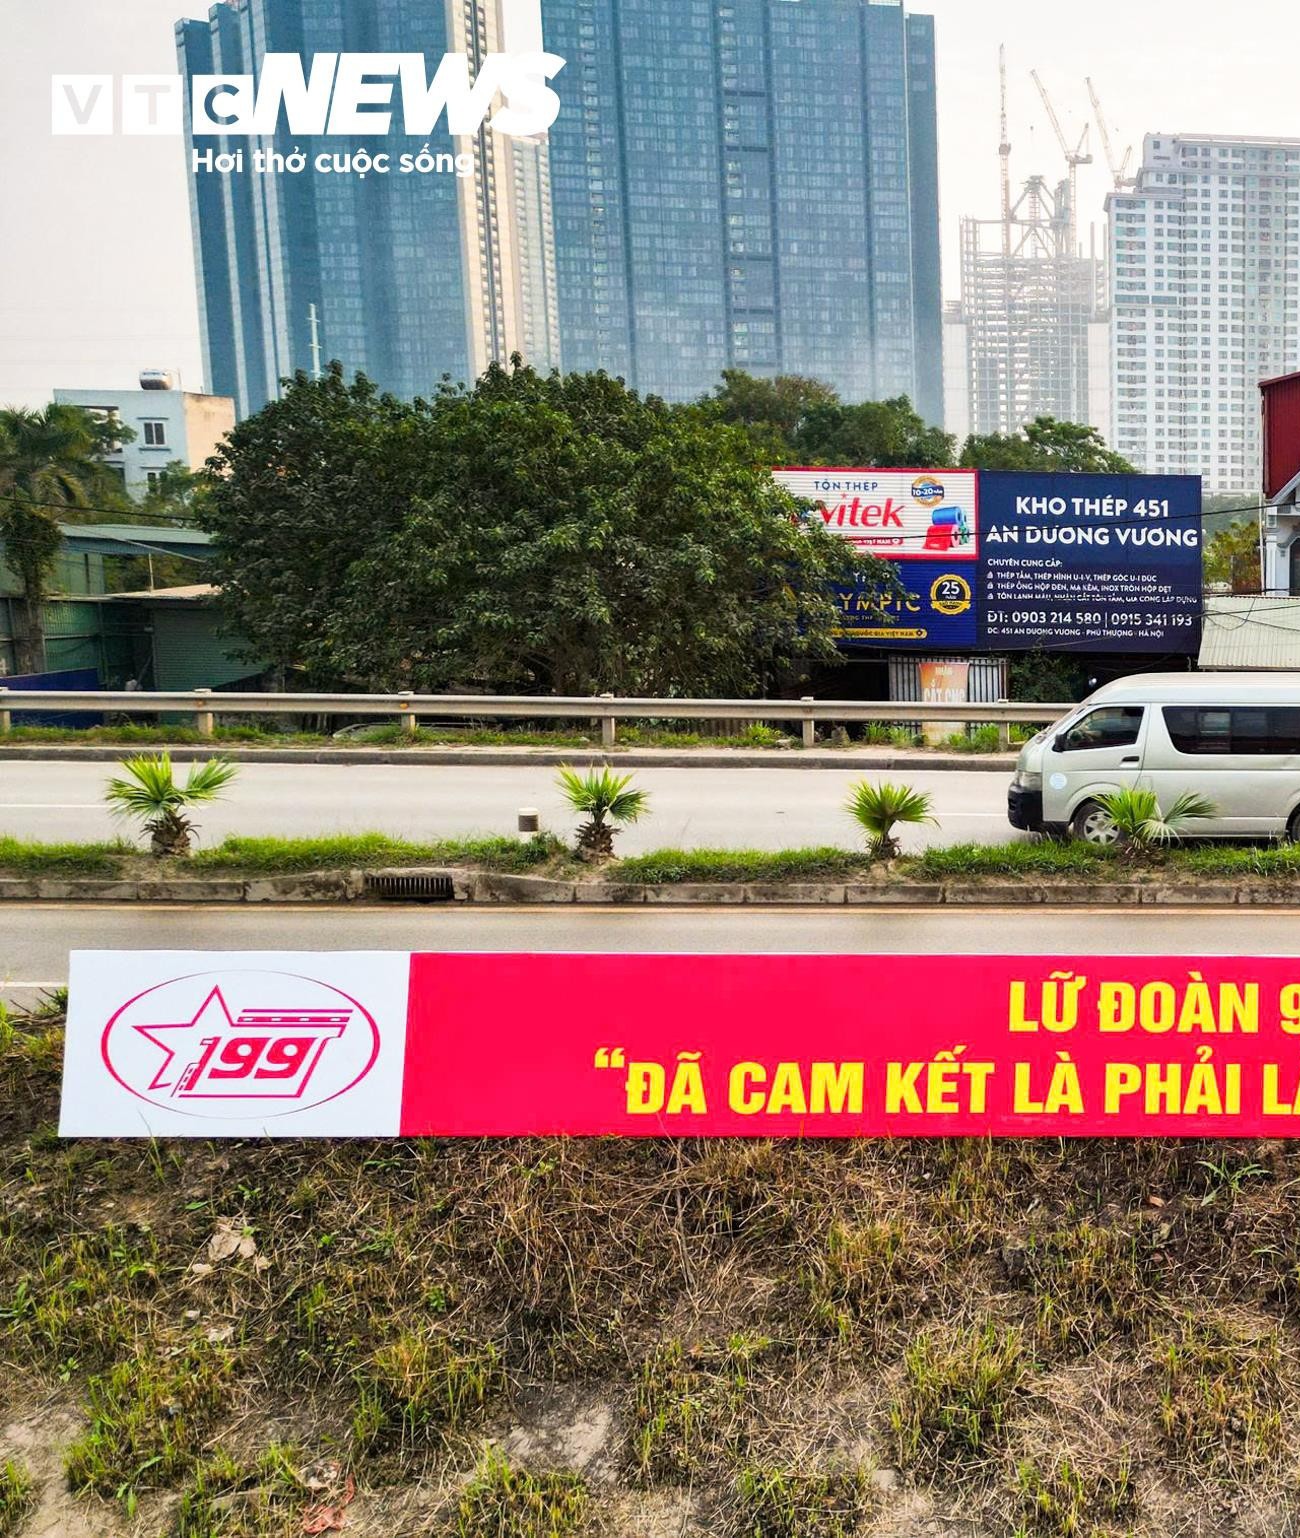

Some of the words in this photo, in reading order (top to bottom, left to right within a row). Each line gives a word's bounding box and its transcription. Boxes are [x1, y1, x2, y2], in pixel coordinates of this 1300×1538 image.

[814, 479, 841, 491] TÔN
[1016, 496, 1067, 515] KHO
[1071, 494, 1128, 516] THÉP
[1132, 499, 1169, 518] 451
[985, 525, 1019, 543] AN
[1115, 526, 1199, 547] VƯƠNG
[987, 557, 1020, 567] CHUYÊN
[1021, 559, 1044, 567] CUNG
[997, 571, 1015, 580] THÉP
[1034, 572, 1052, 581] THÉP
[1093, 573, 1111, 582] THÉP
[941, 581, 960, 595] 25
[997, 582, 1015, 590] THÉP
[997, 592, 1013, 600] TÔN
[1011, 611, 1047, 623] 0903
[1050, 611, 1073, 623] 214
[1075, 612, 1102, 625] 580
[1111, 613, 1142, 625] 0915
[1145, 613, 1168, 626] 341
[1170, 614, 1193, 626] 193
[1001, 627, 1013, 635] 451
[1014, 627, 1025, 635] AN
[1009, 971, 1086, 1032] LỮ
[1097, 971, 1259, 1033] ĐOÀN
[729, 1062, 865, 1114] CAM
[885, 1045, 996, 1113] KẾT
[1013, 1051, 1084, 1113] LÀ
[1104, 1046, 1241, 1114] PHẢI
